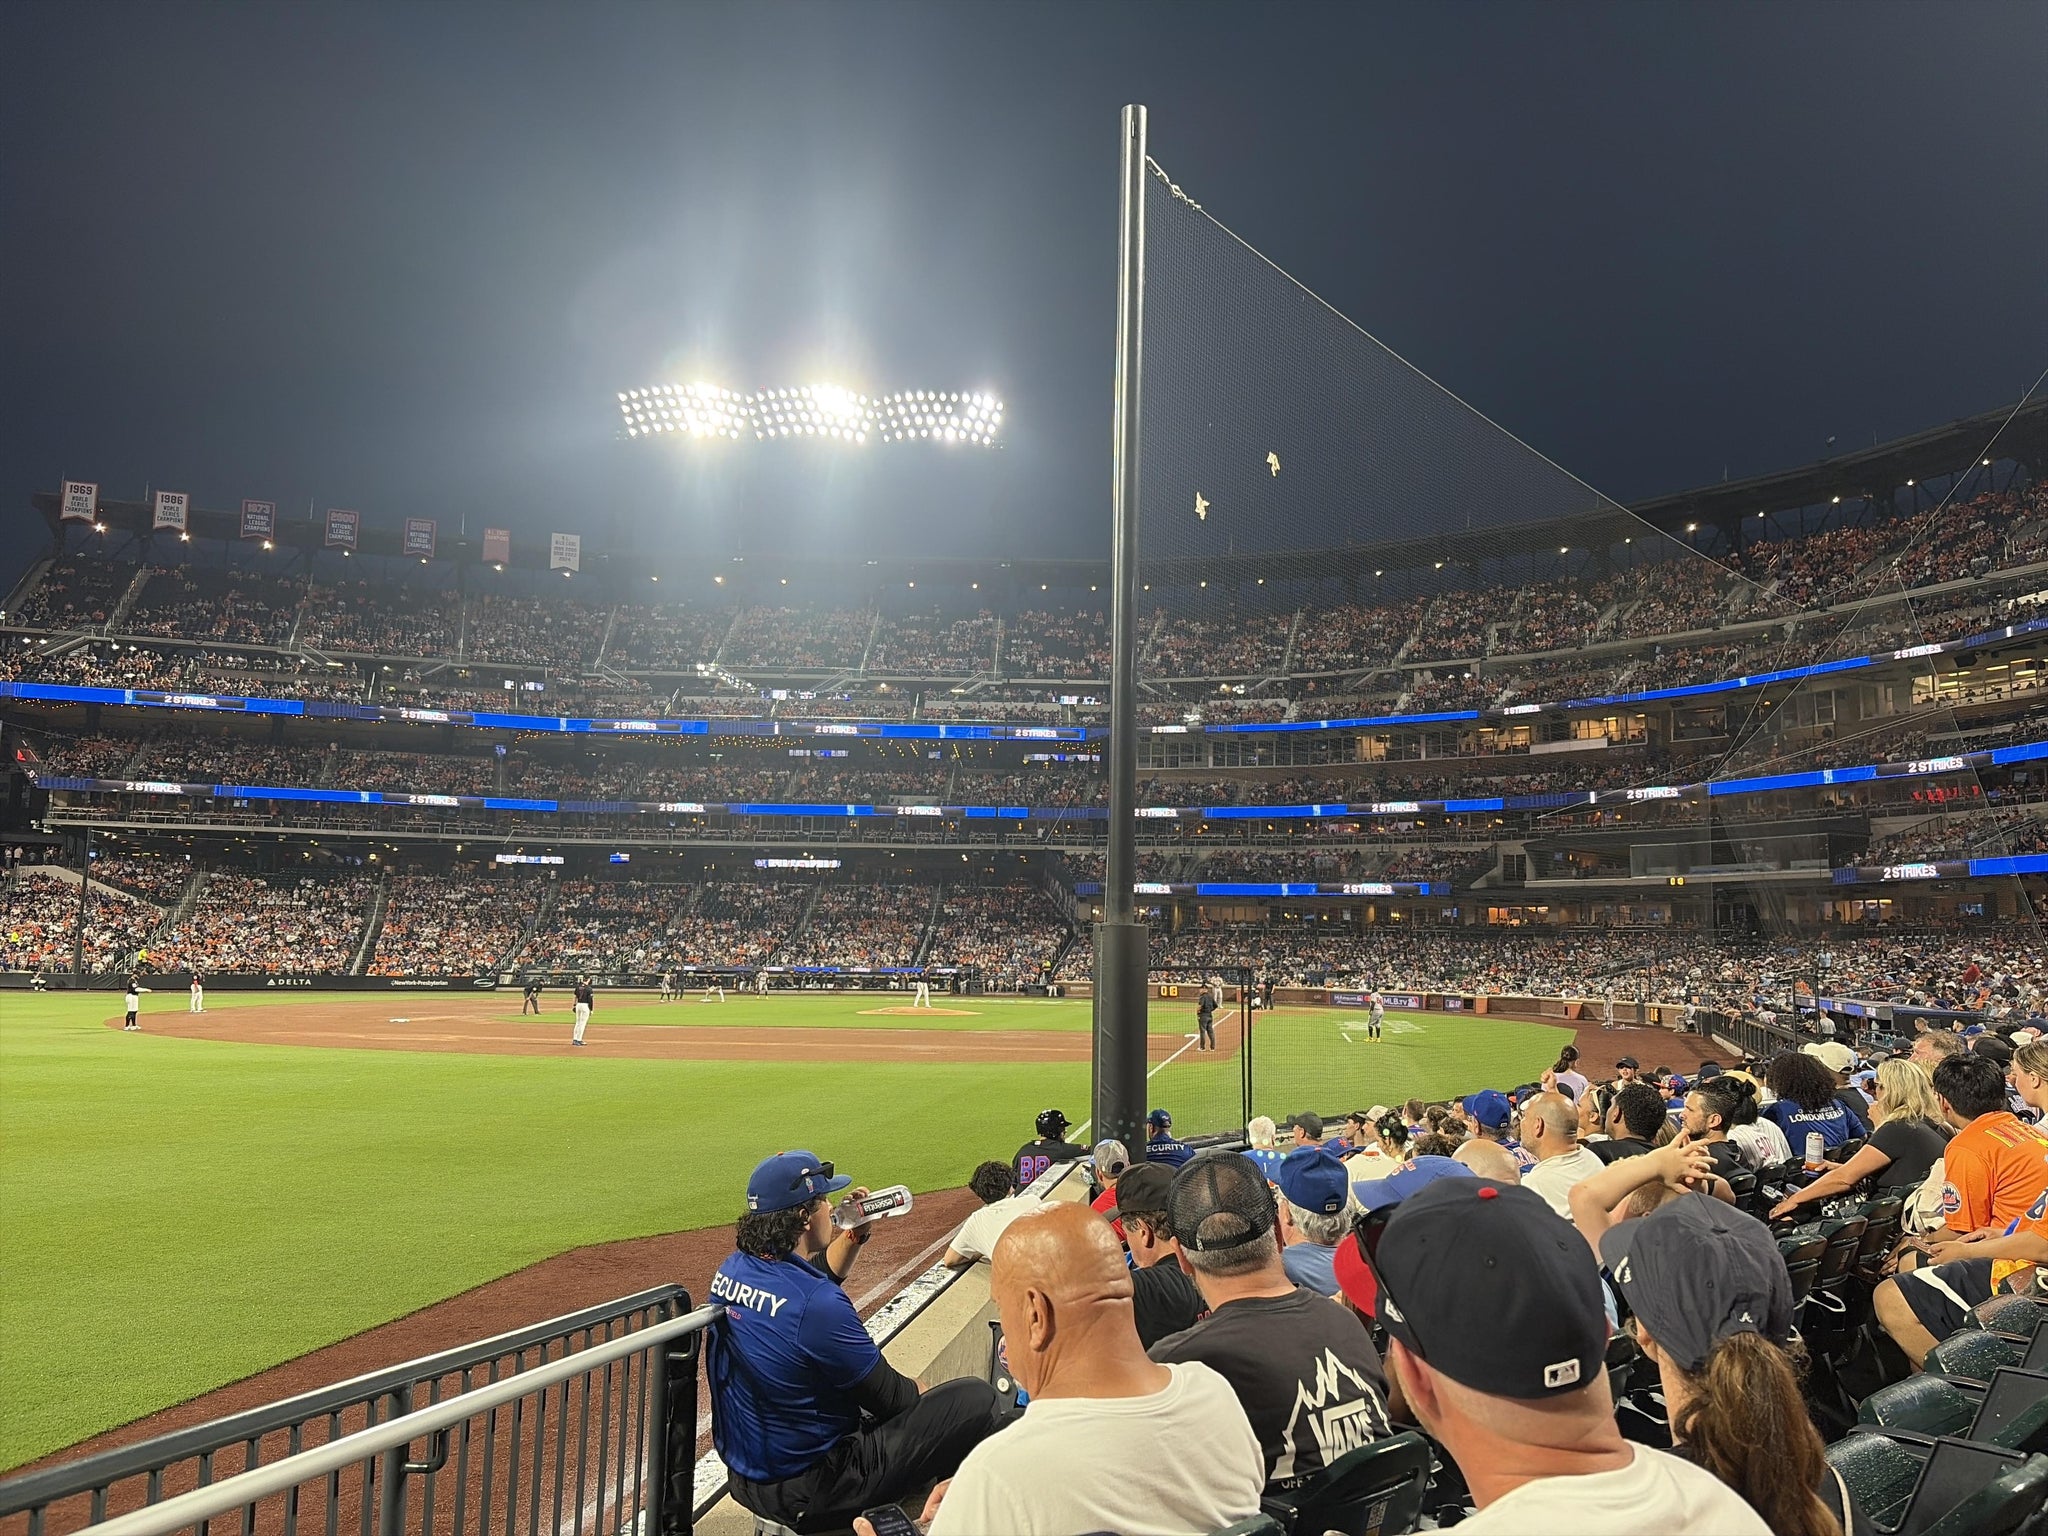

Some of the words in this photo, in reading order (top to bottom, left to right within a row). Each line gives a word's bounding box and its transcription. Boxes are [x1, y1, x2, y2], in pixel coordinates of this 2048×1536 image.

[70, 484, 92, 495] 1969
[161, 494, 183, 504] 1986
[65, 506, 92, 514] CHAMPIONS
[1918, 757, 1963, 772] STRIKES
[135, 782, 181, 793] STRIKES
[1635, 787, 1678, 798] STRIKES
[667, 803, 704, 812] STRIKES
[905, 806, 941, 816] STRIKES
[1380, 802, 1418, 812] STRIKES
[1140, 808, 1177, 817] STRIKES
[1892, 865, 1937, 878] STRIKES
[1351, 883, 1392, 894] STRIKES
[1789, 1113, 1825, 1123] LONDON
[1146, 1144, 1184, 1152] ECURITY
[711, 1271, 788, 1317] ECURITY
[1307, 1398, 1375, 1467] VANS
